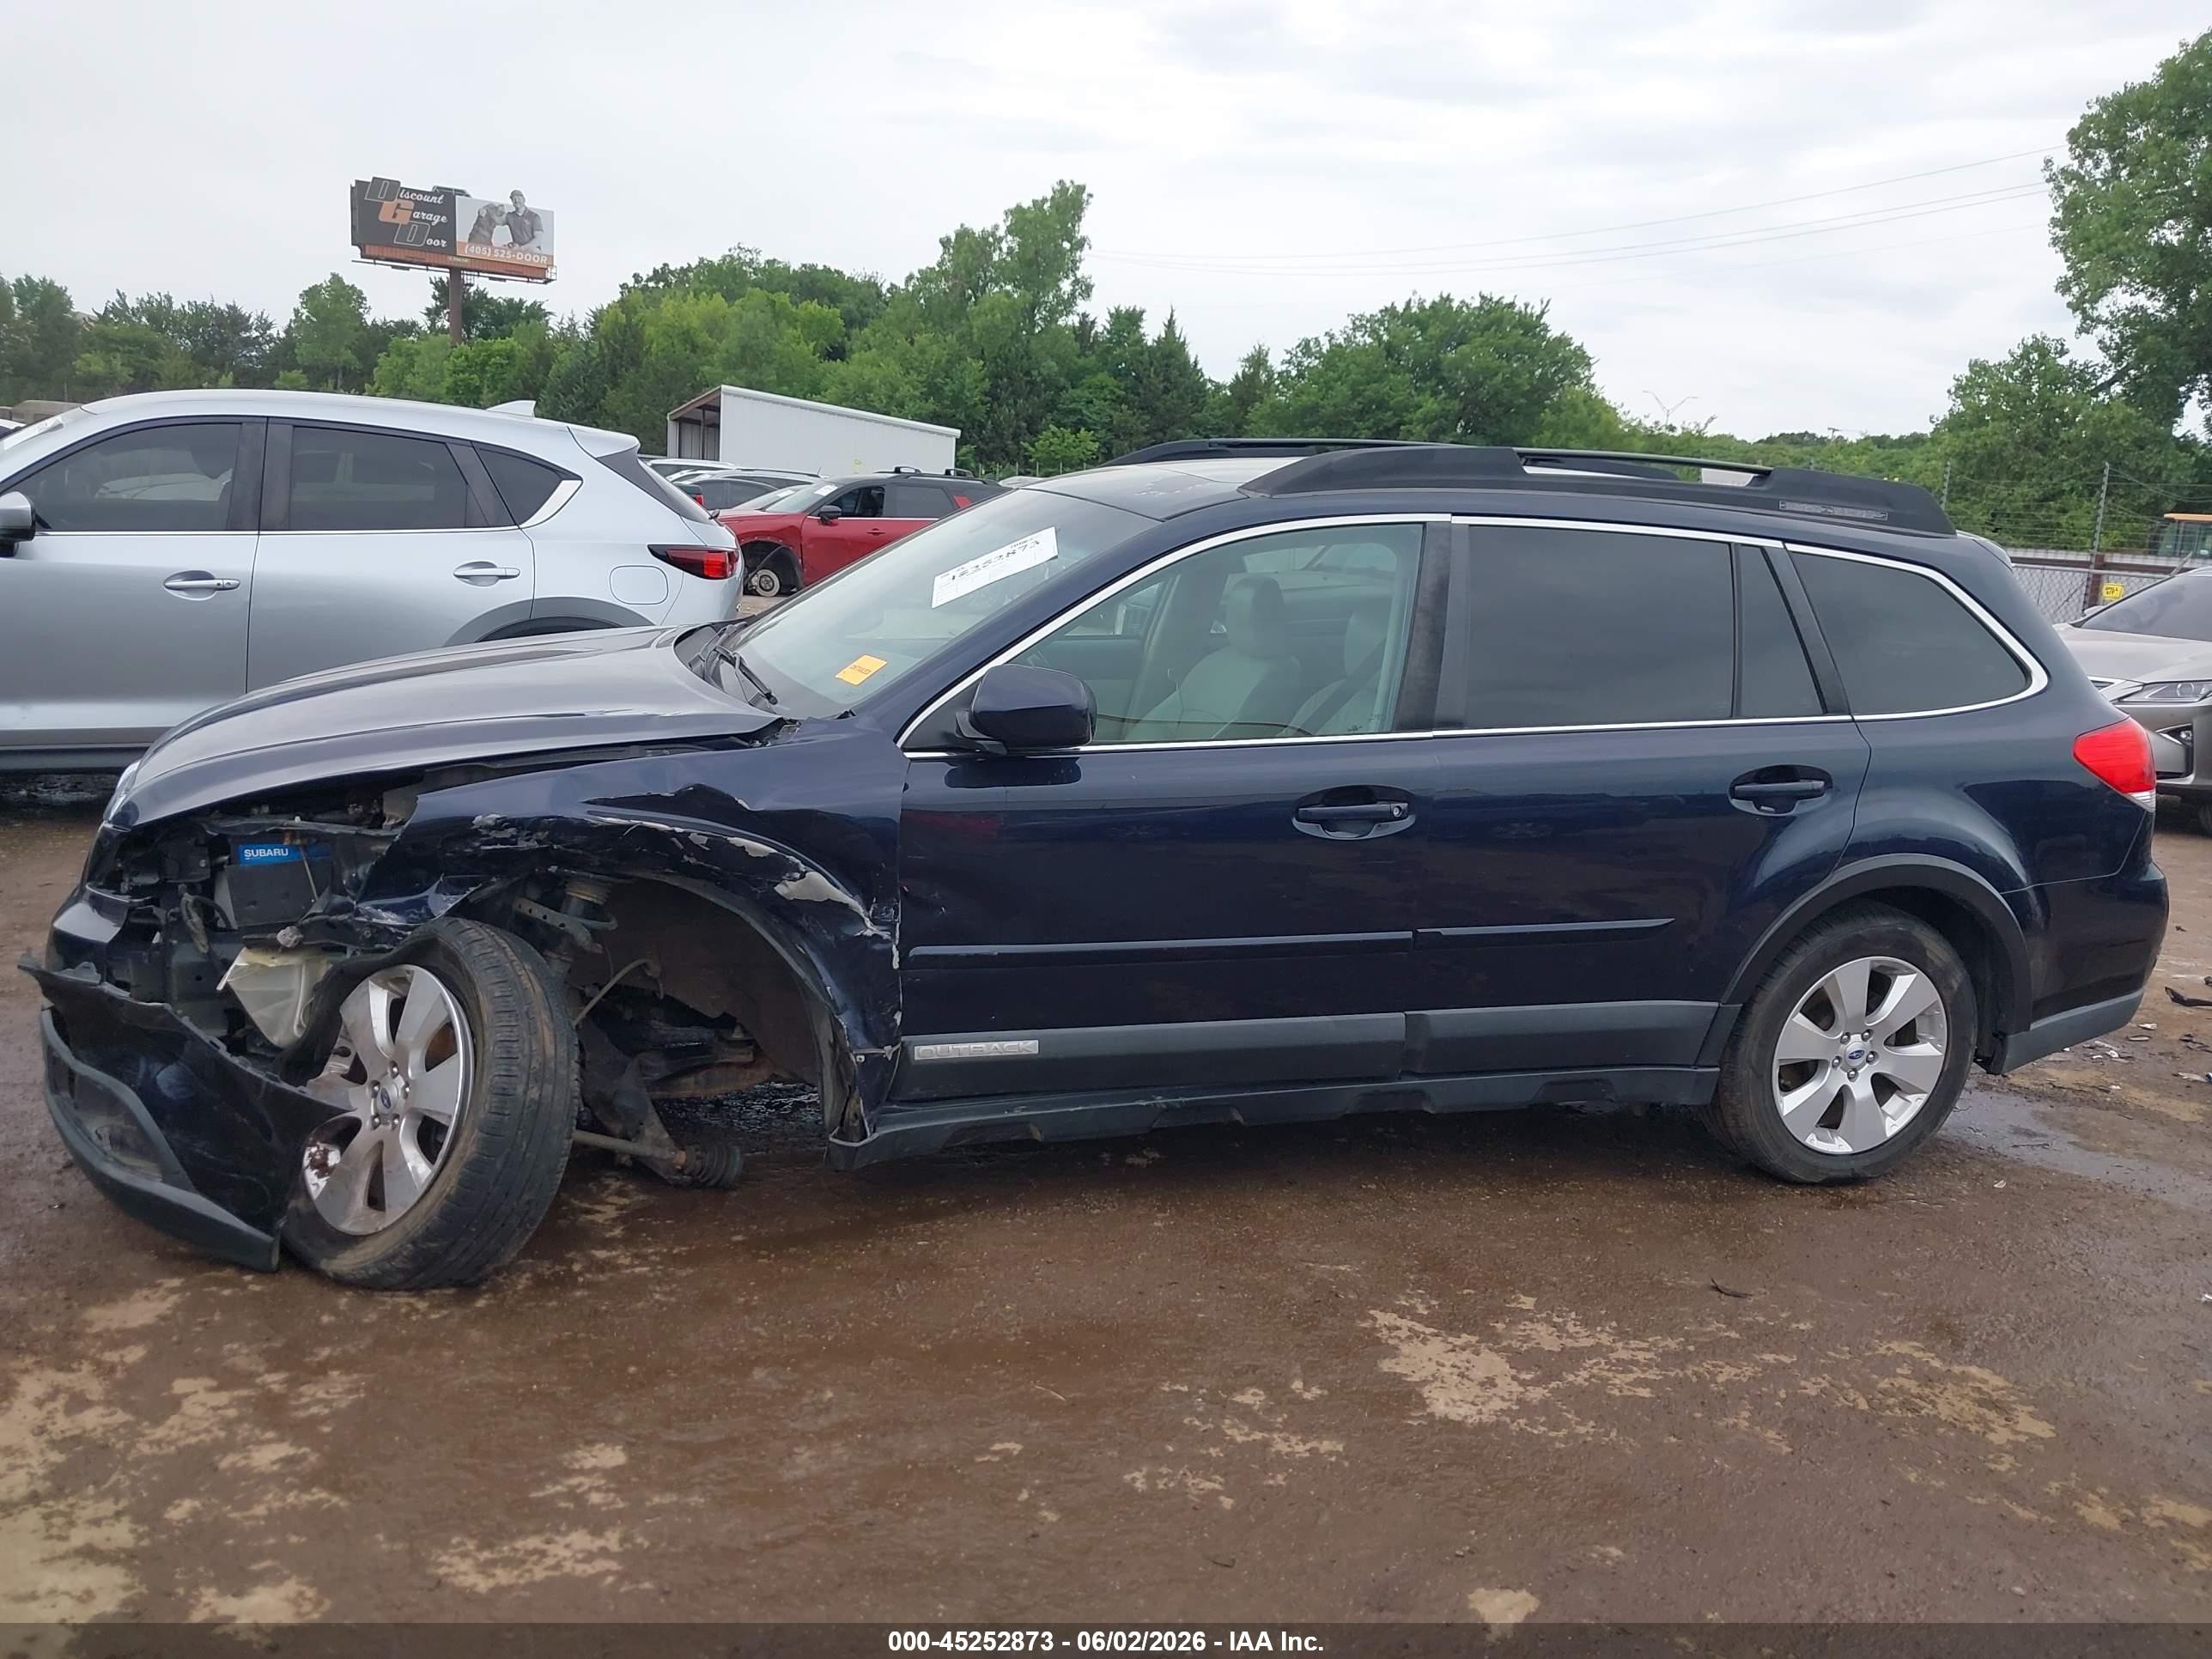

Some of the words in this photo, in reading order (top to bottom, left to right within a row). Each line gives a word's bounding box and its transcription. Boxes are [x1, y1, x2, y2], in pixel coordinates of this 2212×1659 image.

[465, 244, 492, 257] (405)
[494, 249, 548, 264] 525-DOOR
[244, 848, 289, 857] SUBARU
[918, 1041, 1034, 1059] OUTBACK
